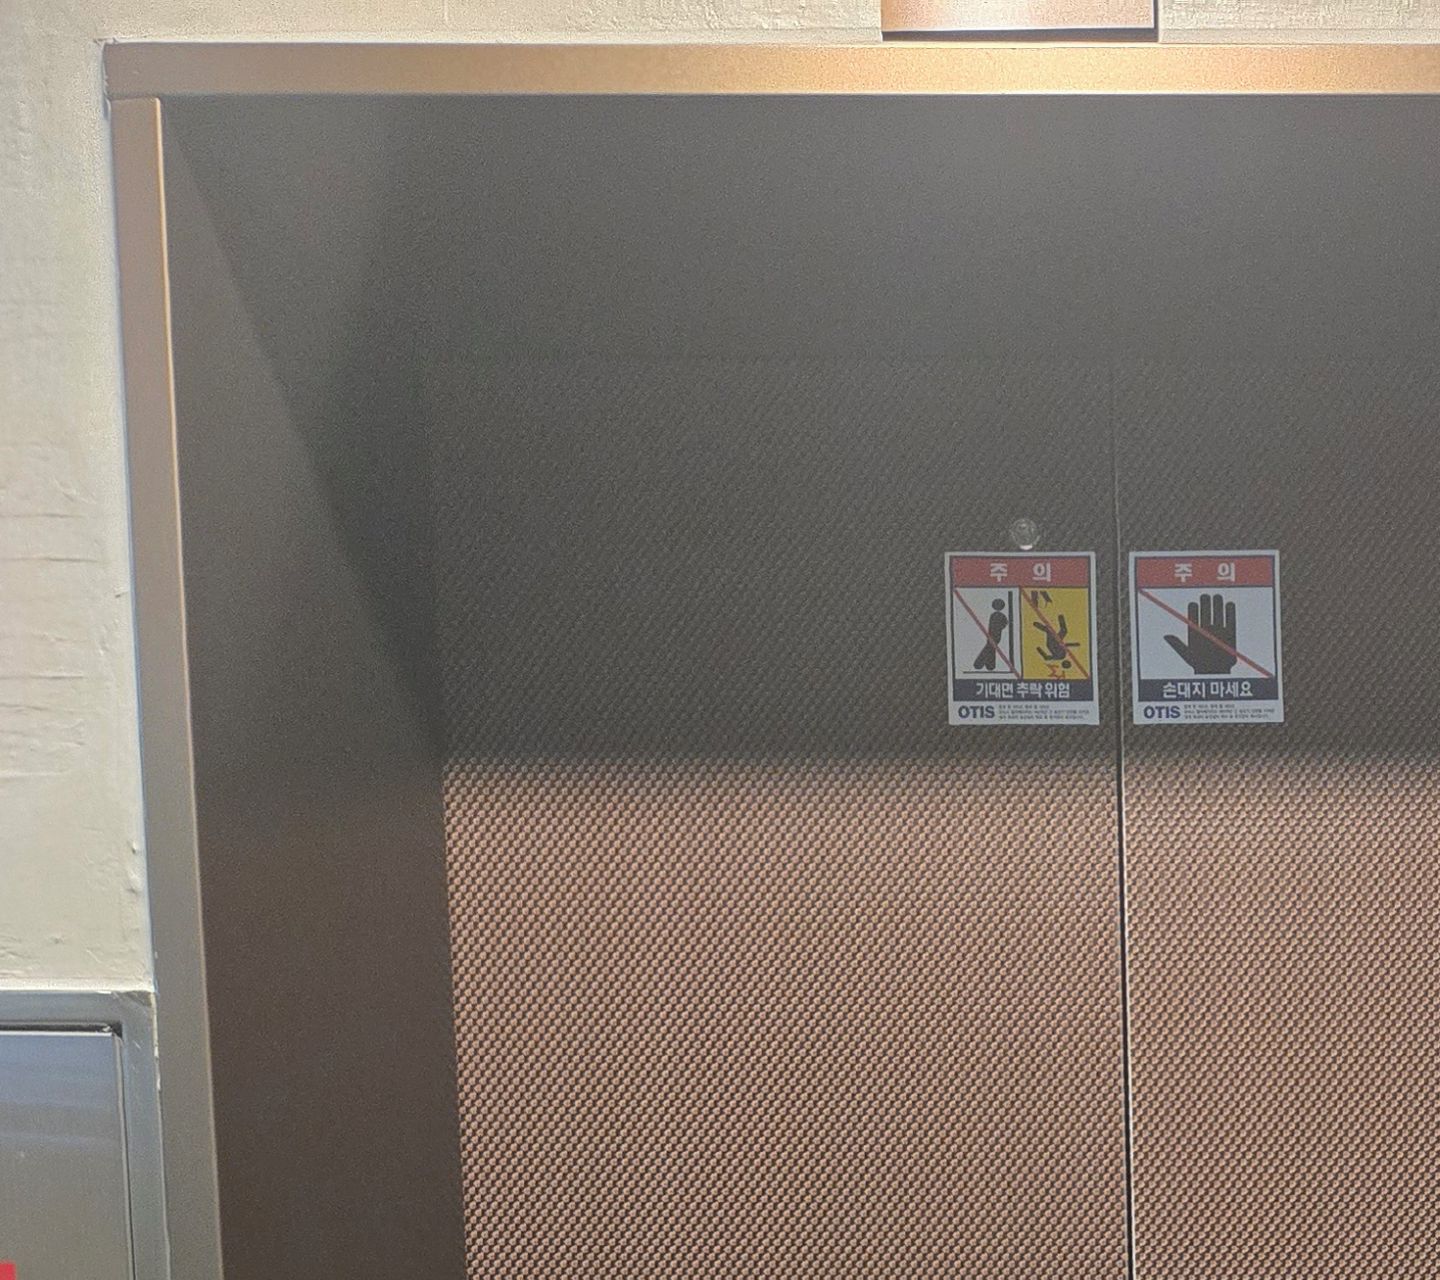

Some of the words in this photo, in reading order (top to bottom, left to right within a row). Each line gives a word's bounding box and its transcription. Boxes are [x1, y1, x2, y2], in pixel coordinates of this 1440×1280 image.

[975, 682, 1014, 699] 기대면
[1162, 681, 1206, 699] 손대지
[1210, 681, 1254, 698] 마세요
[958, 705, 996, 719] OTIS
[1143, 705, 1181, 719] OTIS
